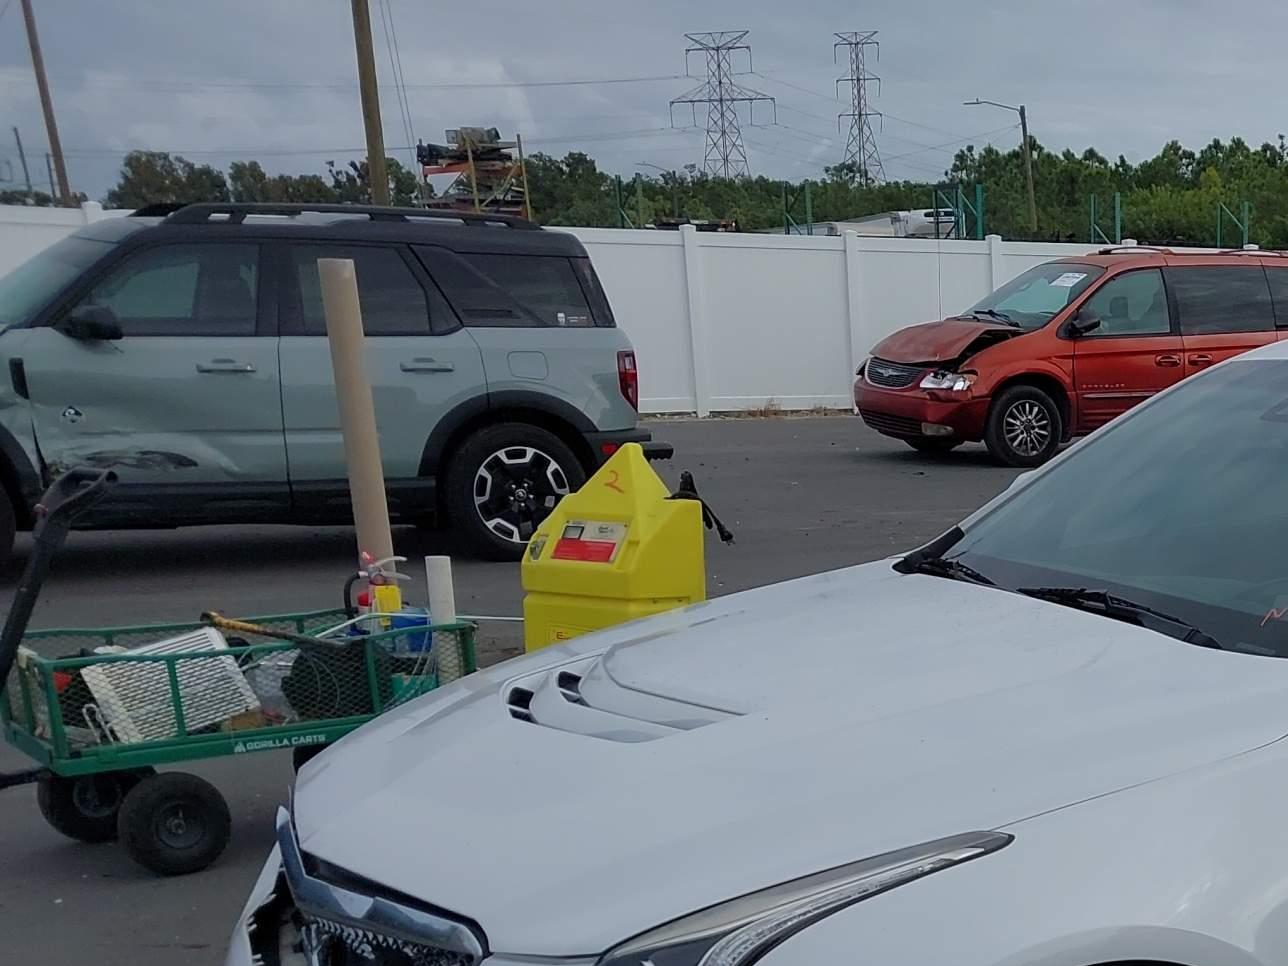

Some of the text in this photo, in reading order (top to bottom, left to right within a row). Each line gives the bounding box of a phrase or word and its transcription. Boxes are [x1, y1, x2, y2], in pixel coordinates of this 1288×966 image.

[604, 470, 624, 493] 2
[246, 735, 326, 750] GORILLA CARTS
